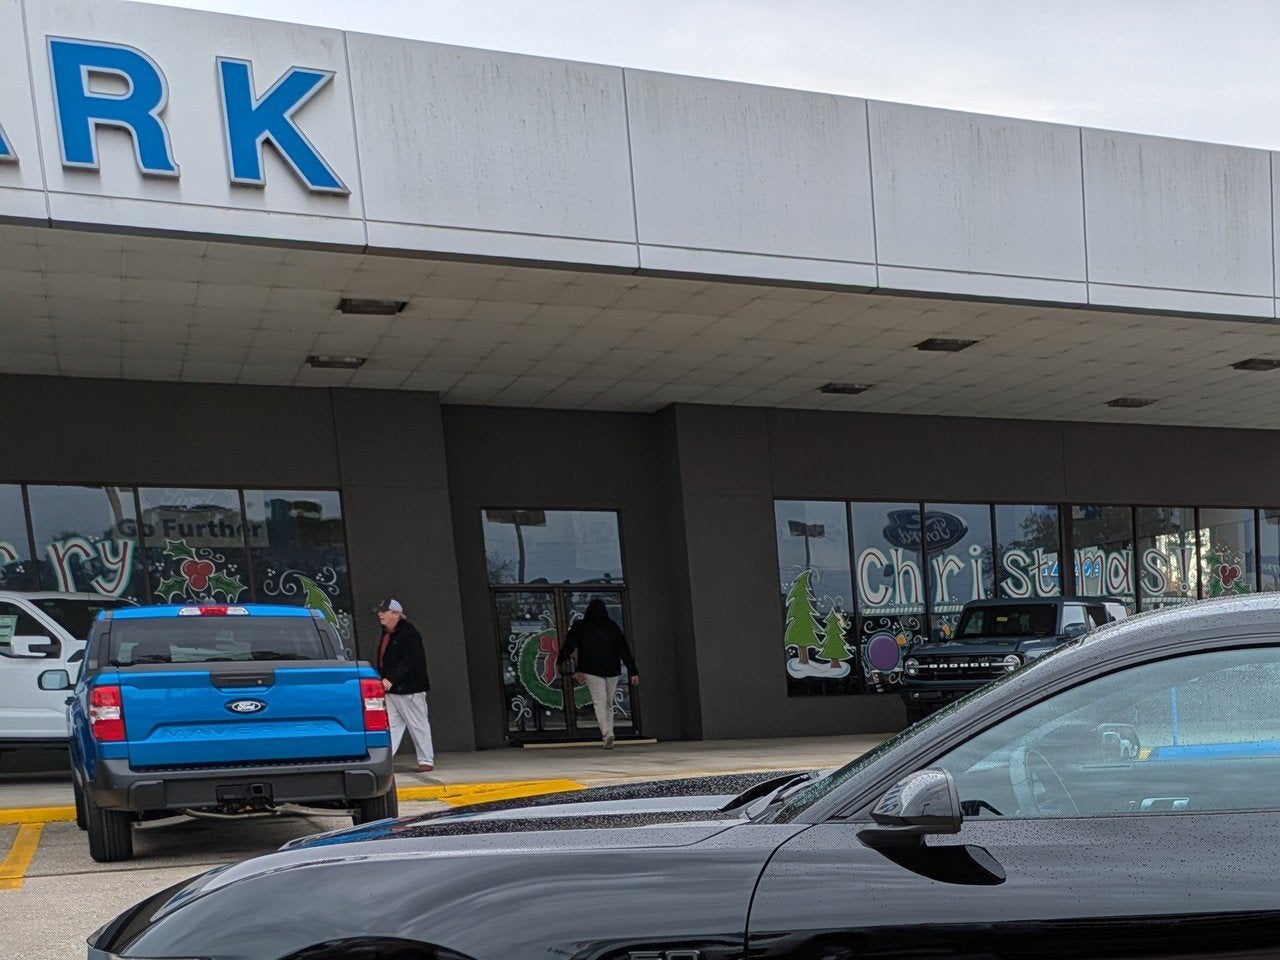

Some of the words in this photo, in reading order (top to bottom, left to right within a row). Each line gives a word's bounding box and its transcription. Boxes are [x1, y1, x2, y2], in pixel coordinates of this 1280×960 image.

[0, 35, 351, 197] RK
[117, 518, 155, 539] Go
[163, 518, 261, 539] Further
[858, 544, 1192, 606] Christmas!
